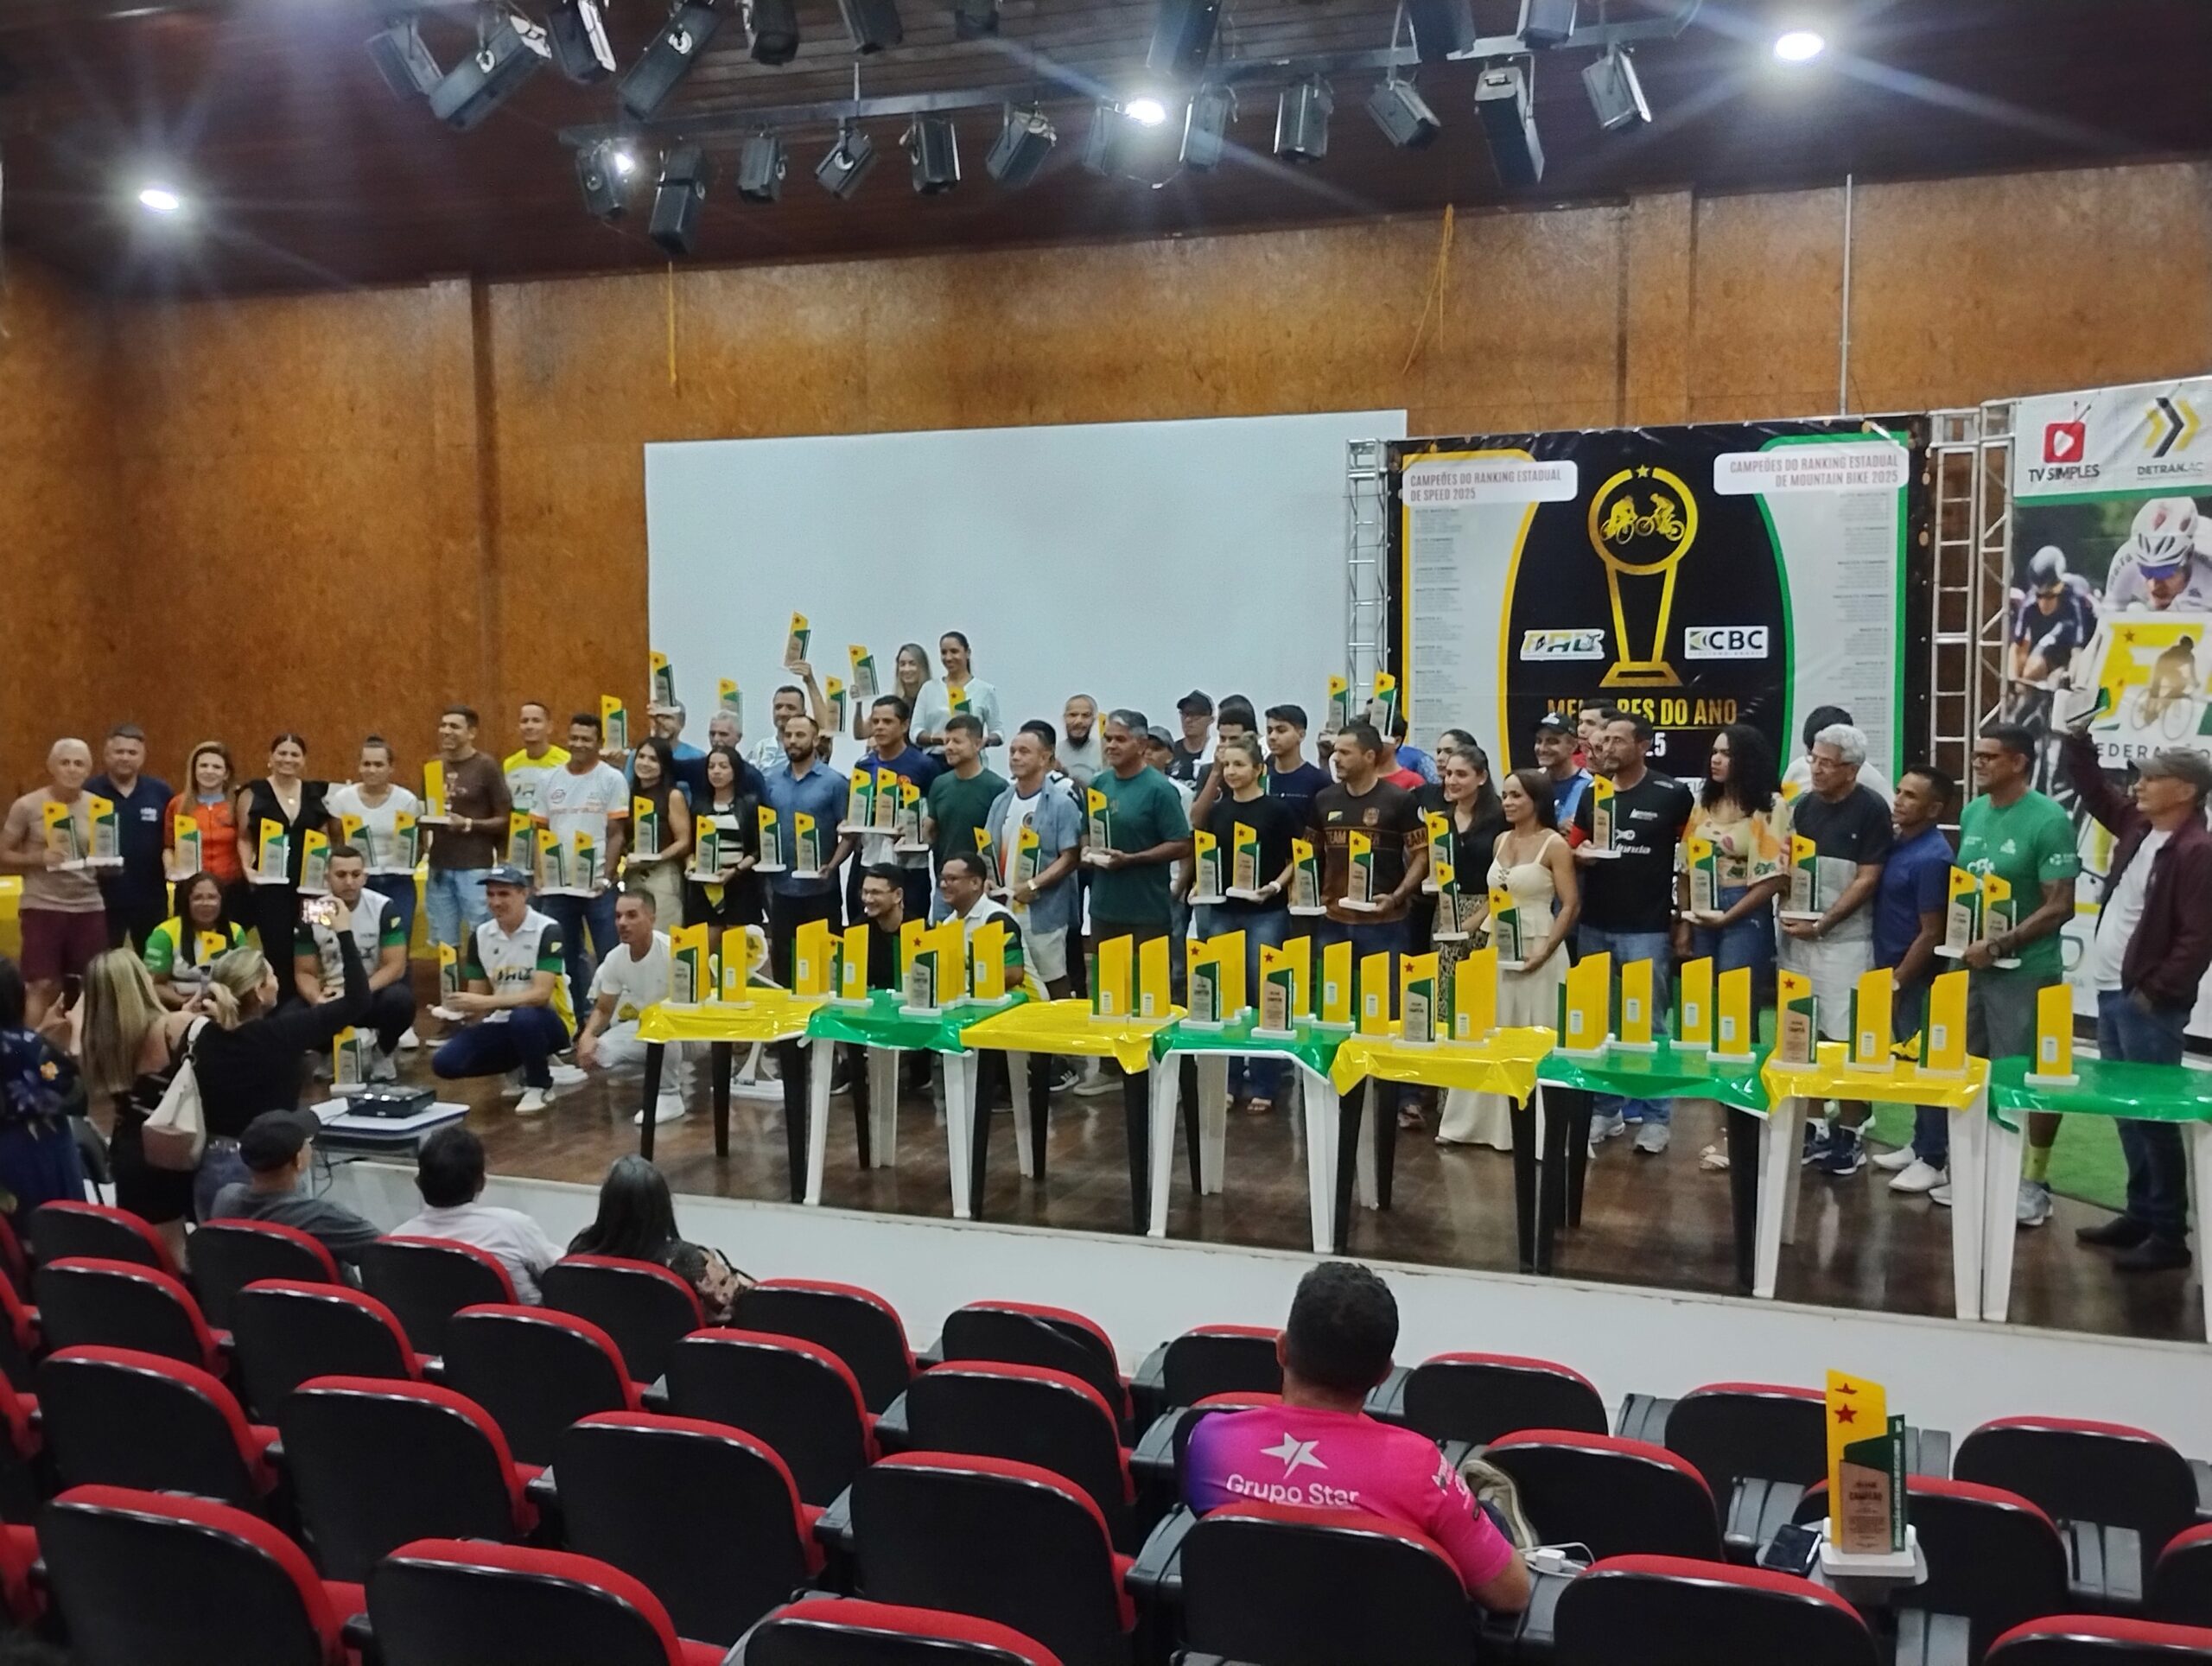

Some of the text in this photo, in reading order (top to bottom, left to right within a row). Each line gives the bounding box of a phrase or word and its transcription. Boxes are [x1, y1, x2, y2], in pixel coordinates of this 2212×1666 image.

[1730, 455, 1898, 473] CAMPEÕES DO RANKING ESTADUAL
[2028, 464, 2100, 482] TV SIMPLES
[1410, 469, 1561, 487] CAMPEÕES DO RANKING ESTADUAL
[1776, 471, 1898, 487] DE MOUNTAIN BIKE 2025
[1410, 487, 1476, 502] DE SPEED 2025
[1709, 630, 1764, 650] CBC
[1660, 698, 1693, 726] DO
[1694, 698, 1737, 725] ANO
[1226, 1473, 1360, 1506] Grupo Star
